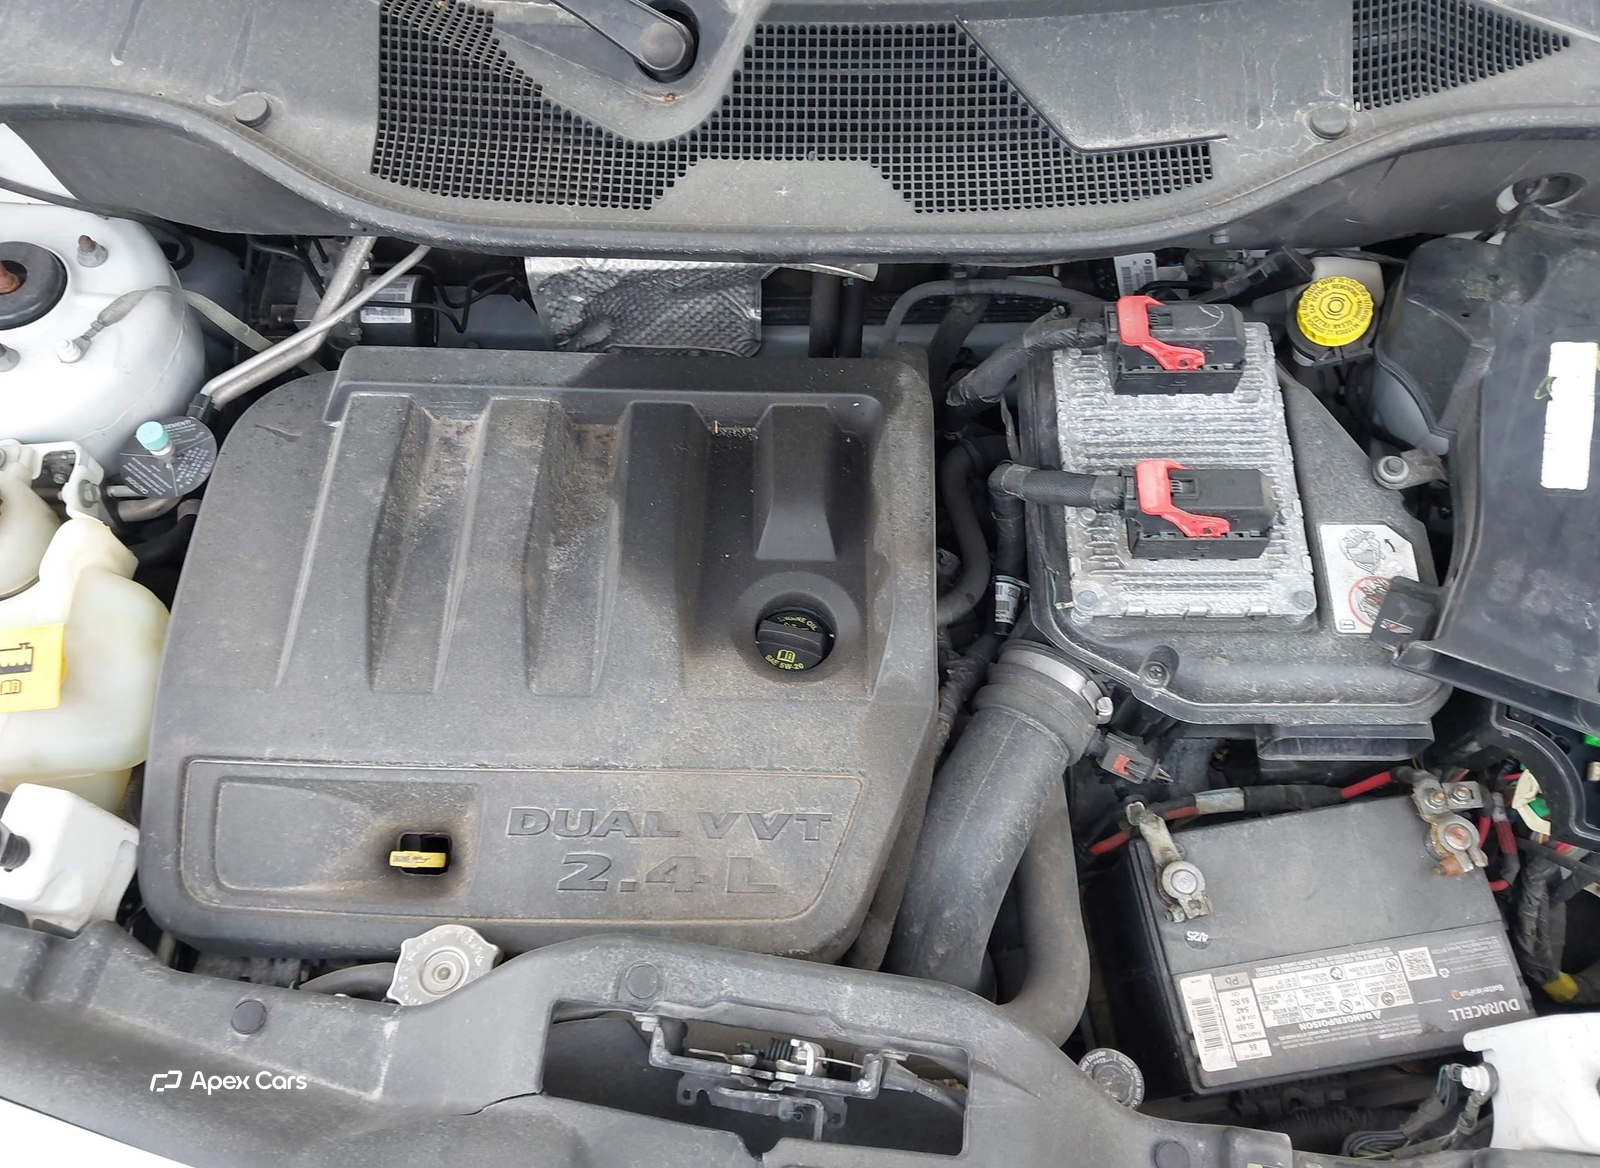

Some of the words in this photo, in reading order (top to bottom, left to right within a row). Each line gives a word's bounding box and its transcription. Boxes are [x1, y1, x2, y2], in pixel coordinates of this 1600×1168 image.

[806, 620, 818, 631] OIL
[765, 654, 779, 666] SAE
[779, 662, 804, 670] 5W-20
[507, 806, 681, 838] DUAL
[697, 811, 833, 842] VVT
[1186, 930, 1208, 942] 4/25
[1225, 976, 1240, 987] Pb
[1448, 998, 1521, 1021] DURACELL
